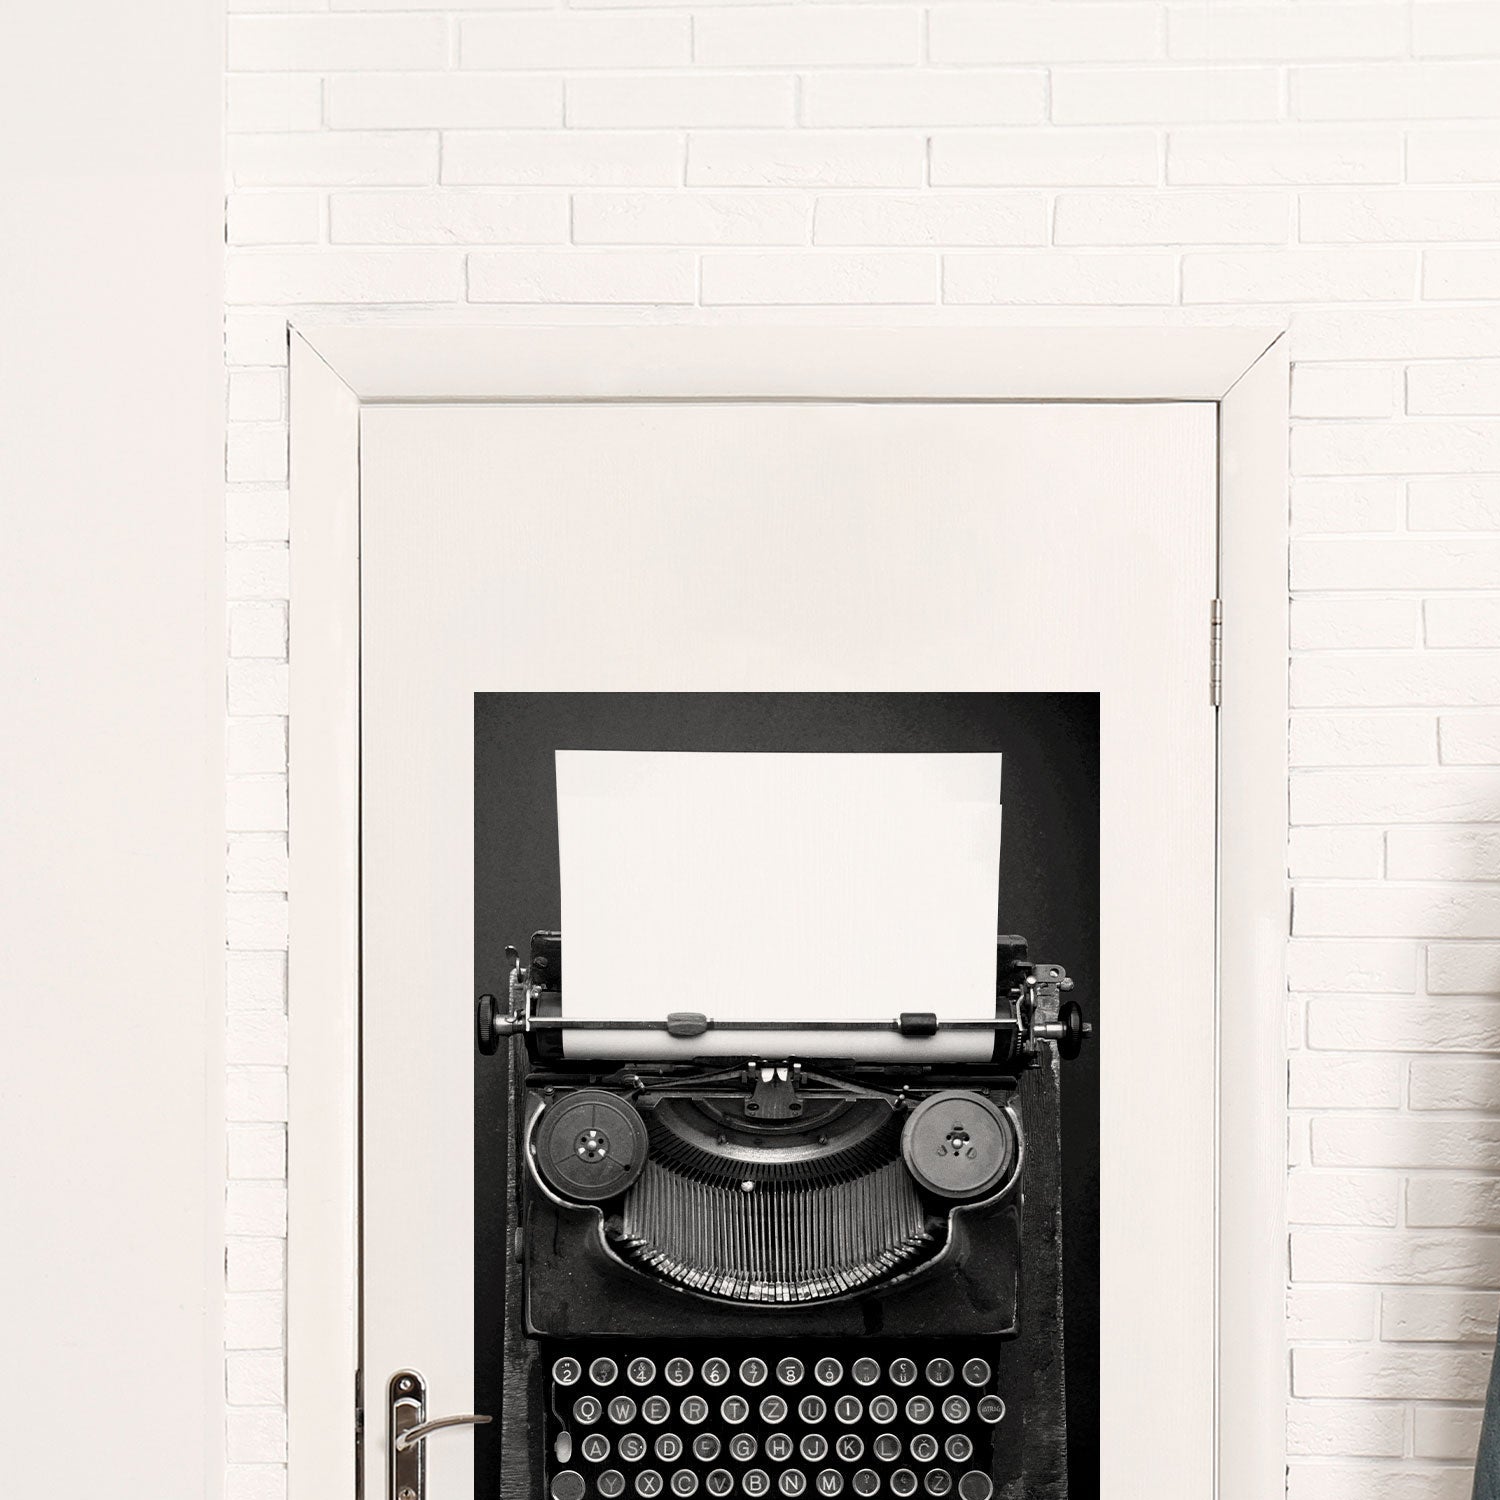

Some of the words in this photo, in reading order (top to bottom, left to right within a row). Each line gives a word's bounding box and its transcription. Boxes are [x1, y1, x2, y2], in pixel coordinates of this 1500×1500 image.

[563, 1370, 571, 1381] 2
[636, 1370, 646, 1381] 4
[675, 1371, 682, 1381] 5
[711, 1370, 719, 1381] 6
[749, 1371, 757, 1381] 7
[786, 1370, 796, 1381] 8
[825, 1372, 834, 1383] 9
[581, 1402, 595, 1420] Q
[615, 1404, 629, 1419] W
[651, 1403, 662, 1418] E
[689, 1403, 700, 1419] R
[729, 1403, 740, 1418] T
[768, 1403, 780, 1418] Z
[808, 1403, 818, 1418] U
[846, 1403, 850, 1417] I
[876, 1403, 889, 1418] O
[914, 1403, 925, 1419] P
[950, 1400, 962, 1419] Š
[590, 1441, 602, 1456] A
[627, 1441, 638, 1456] S
[663, 1441, 675, 1456] D
[737, 1441, 750, 1456] G
[773, 1441, 784, 1455] H
[808, 1441, 819, 1456] J
[845, 1441, 855, 1455] K
[882, 1442, 892, 1455] L
[918, 1440, 930, 1457] Č
[604, 1478, 618, 1493] Y
[643, 1477, 655, 1492] X
[678, 1476, 691, 1492] C
[714, 1478, 726, 1491] V
[750, 1476, 762, 1491] B
[785, 1476, 798, 1491] N
[823, 1476, 836, 1490] M
